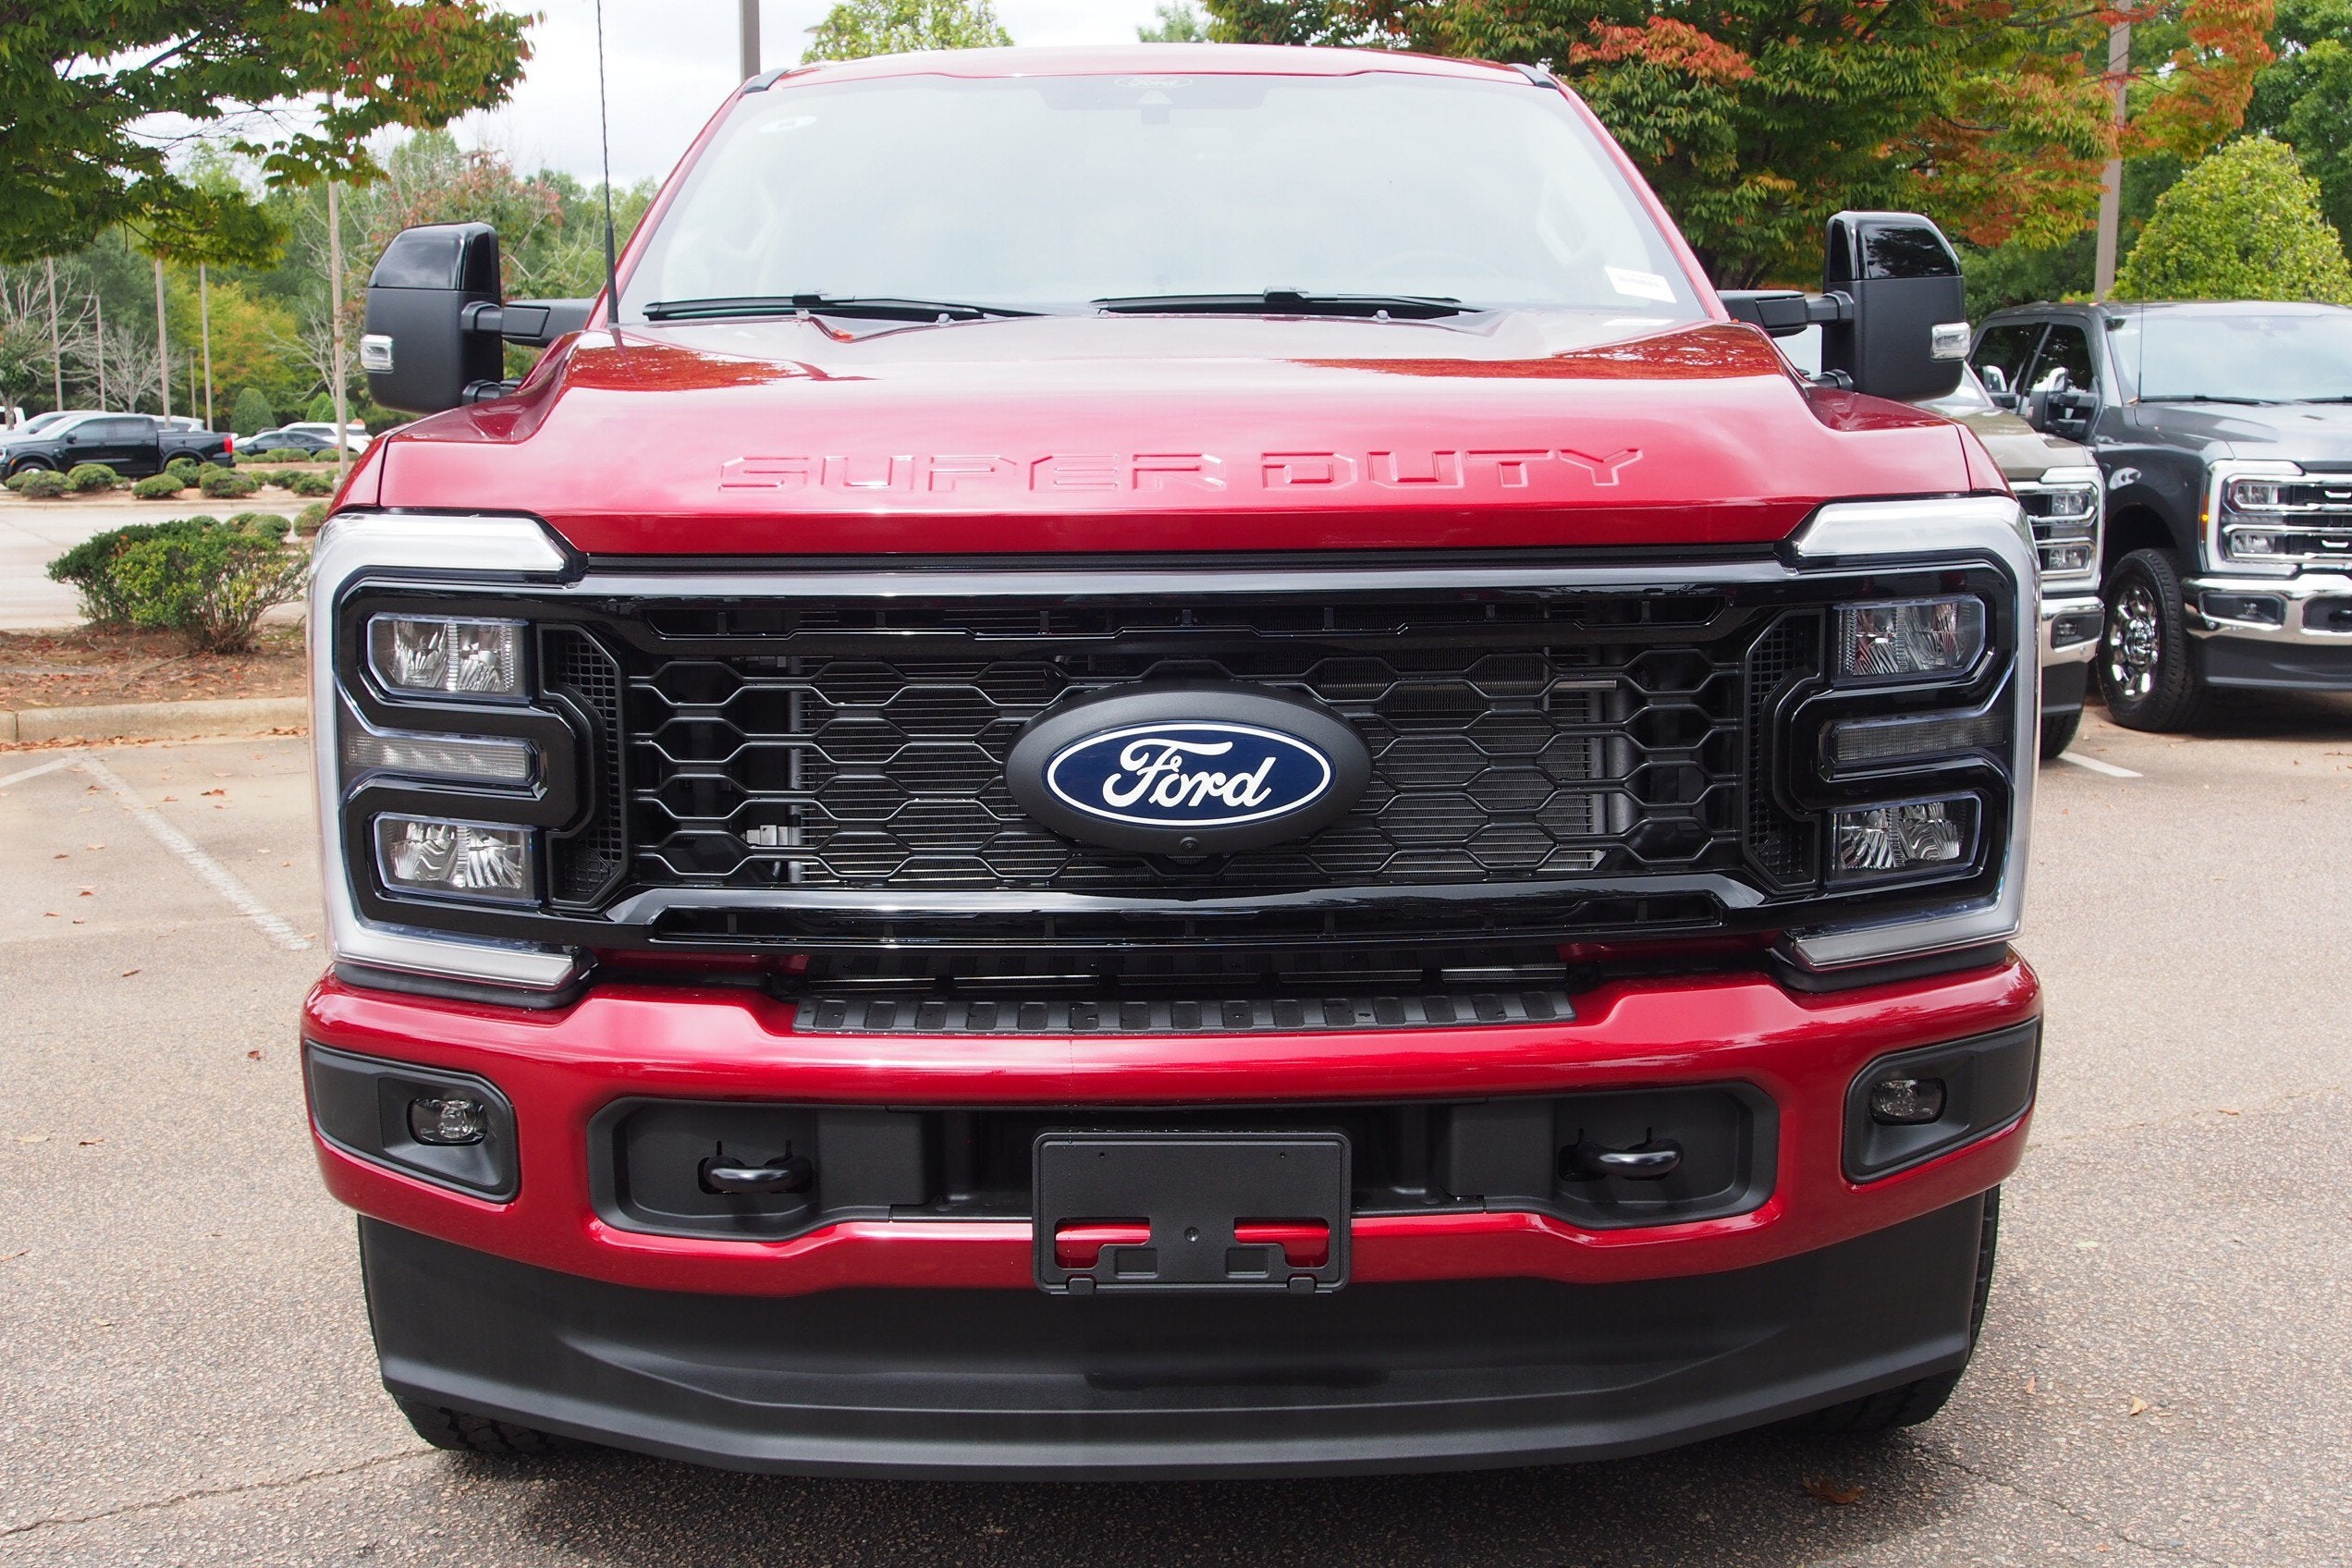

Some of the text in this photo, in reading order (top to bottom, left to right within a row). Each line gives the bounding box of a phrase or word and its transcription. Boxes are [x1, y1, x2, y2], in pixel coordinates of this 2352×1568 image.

[719, 448, 1644, 492] SUPER DUTY
[1102, 739, 1277, 807] Ford
